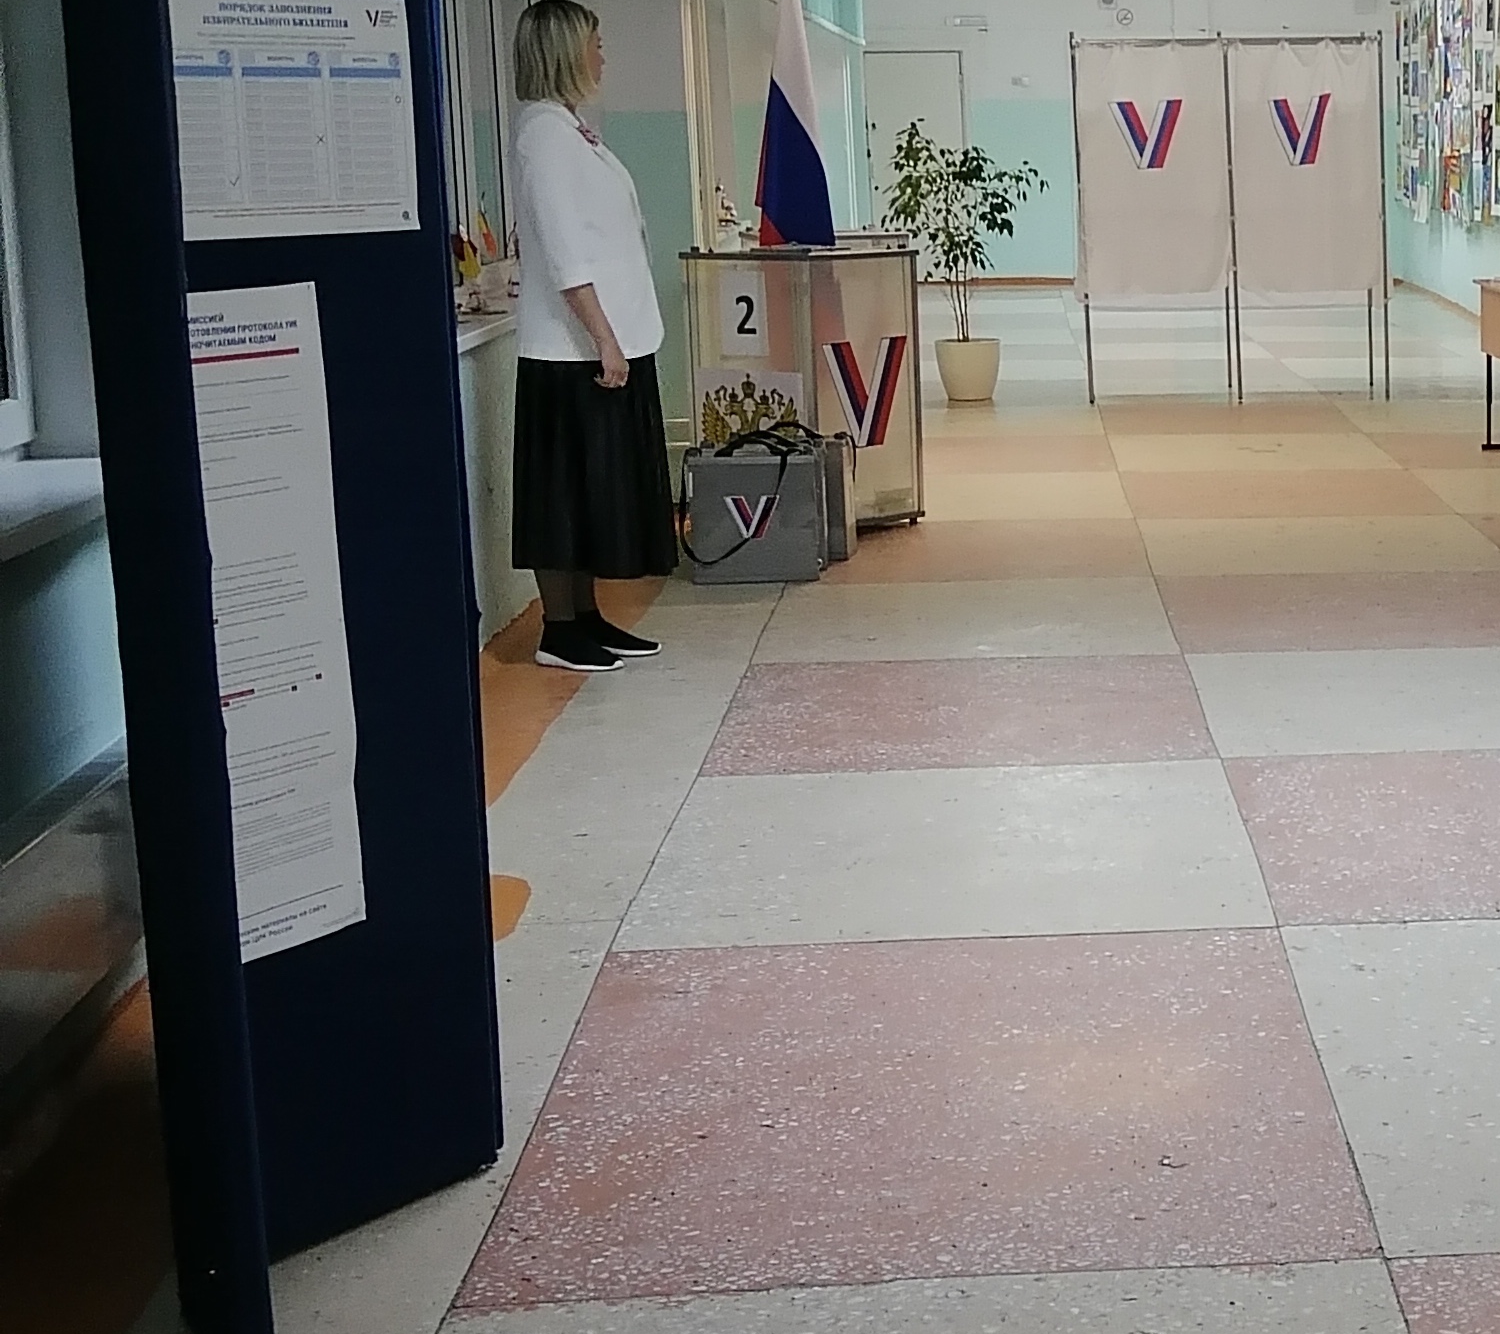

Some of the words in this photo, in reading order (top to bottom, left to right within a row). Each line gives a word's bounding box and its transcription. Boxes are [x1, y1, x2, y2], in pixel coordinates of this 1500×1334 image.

[735, 295, 757, 334] 2
[237, 321, 284, 334] ПРОТОКОЛА
[248, 334, 276, 344] КОДОМ
